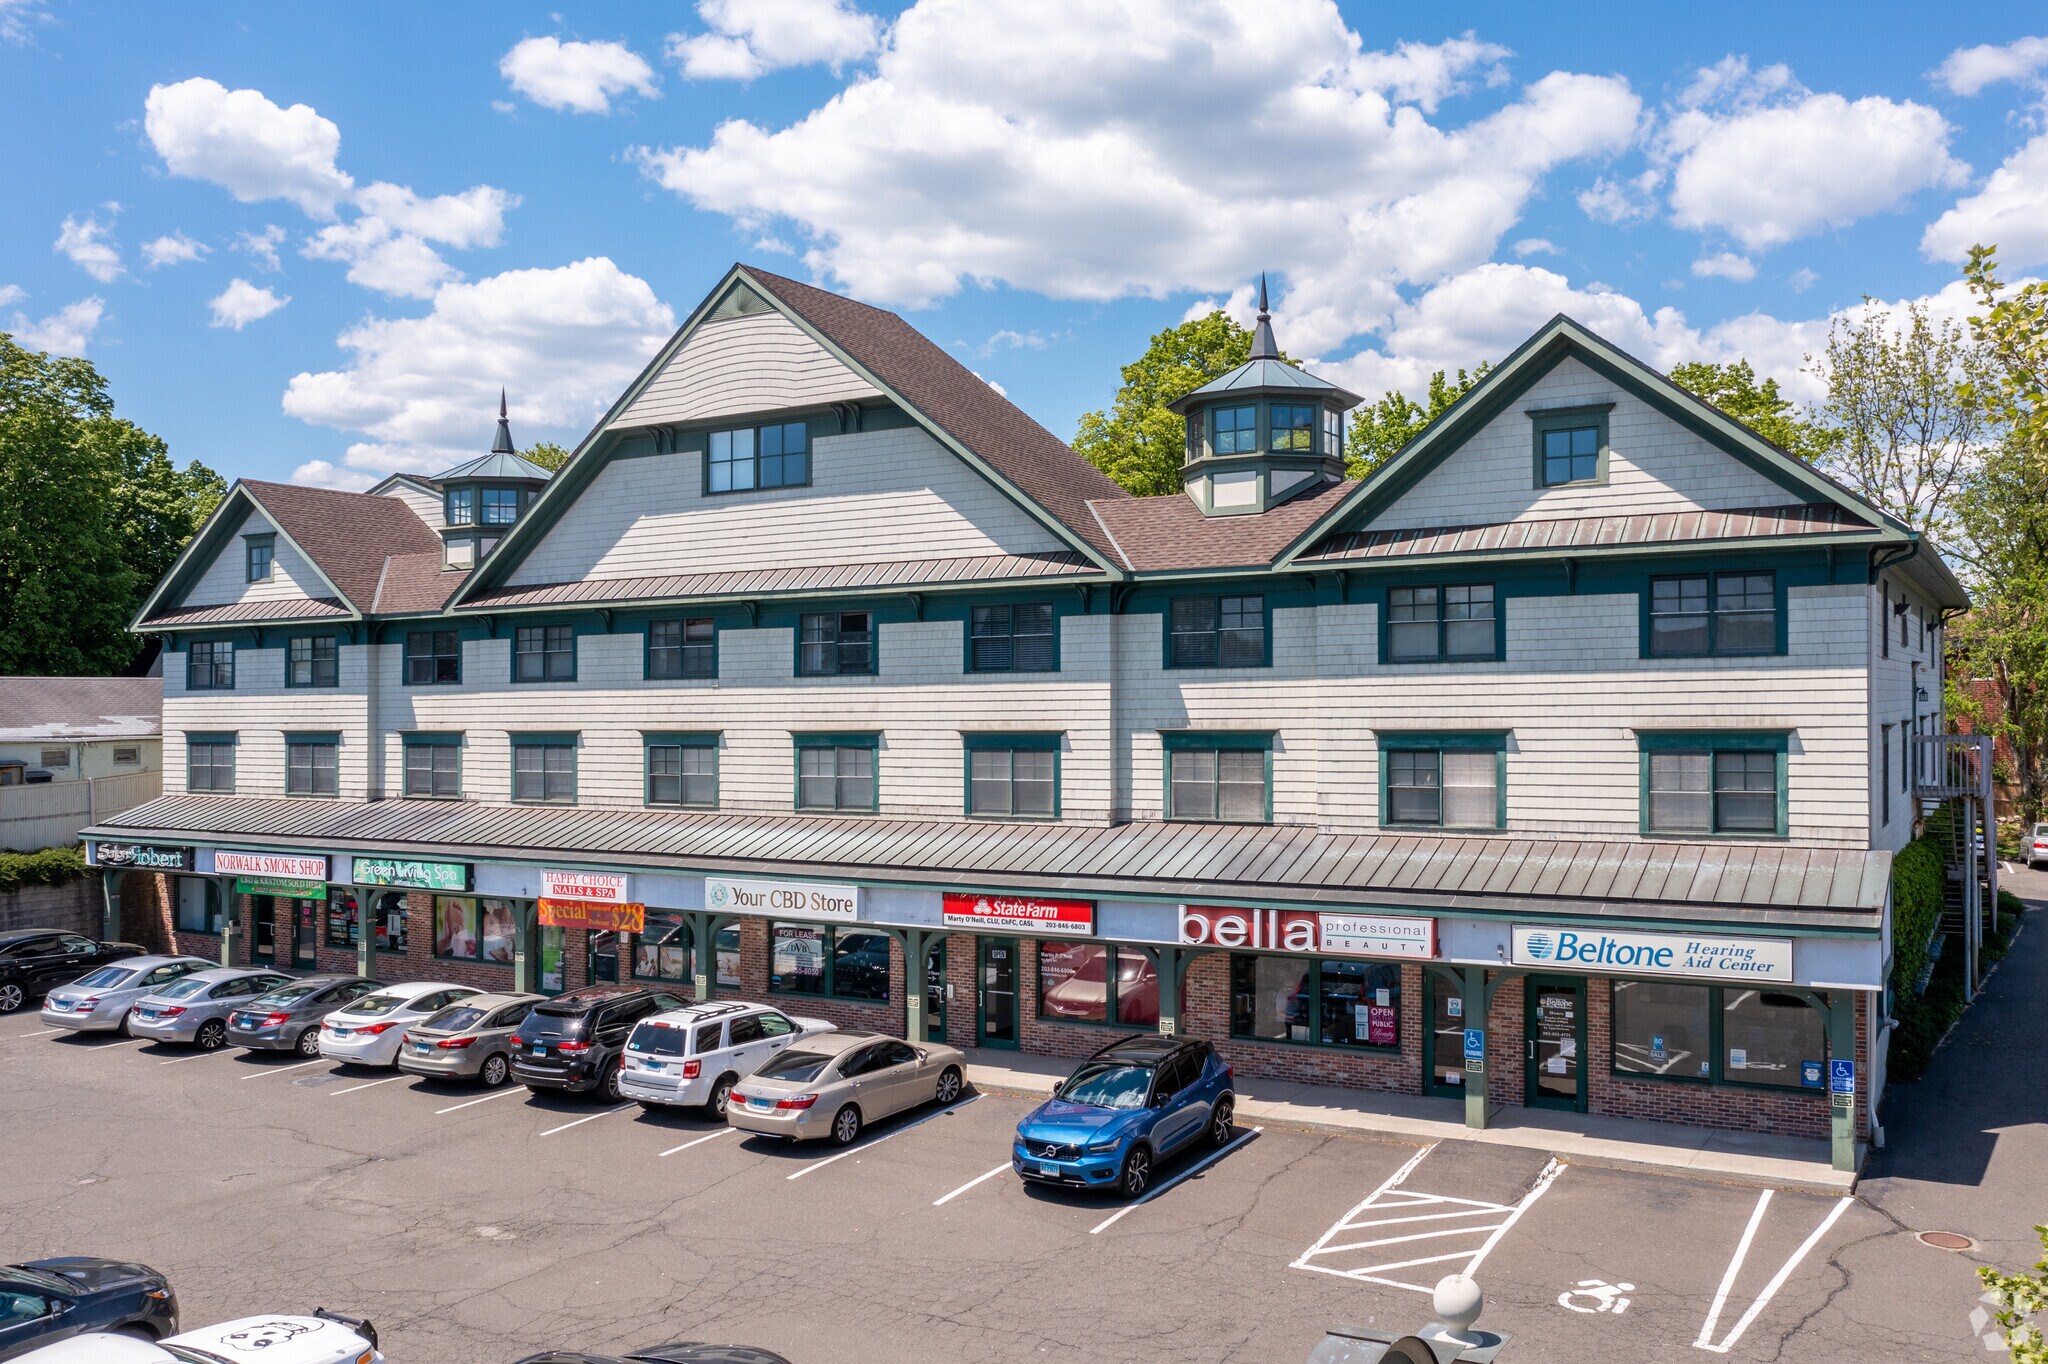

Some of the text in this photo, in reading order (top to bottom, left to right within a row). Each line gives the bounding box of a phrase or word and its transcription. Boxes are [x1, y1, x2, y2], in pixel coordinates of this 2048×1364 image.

[128, 846, 182, 867] Robert
[217, 855, 324, 876] NORWALK SMOKE SHOP
[360, 861, 457, 884] Green Living Spa
[240, 875, 254, 884] CBD
[260, 877, 287, 887] KRATOM
[288, 879, 305, 888] SOLD
[306, 881, 323, 889] HERE
[546, 872, 623, 888] HAPPY CHOICE
[554, 885, 614, 898] NAILS & SPA
[732, 886, 853, 913] Your CBD Store
[540, 898, 588, 924] Special
[587, 903, 612, 912] Manicure
[588, 918, 610, 927] Pedicure
[612, 902, 644, 931] $28
[947, 915, 965, 924] Marty
[966, 916, 986, 925] O'Neill,
[986, 918, 1001, 926] CLU,
[1045, 921, 1086, 931] 203-846-6803
[779, 929, 817, 940] FOR LEASE
[1178, 904, 1319, 952] bella
[1325, 921, 1427, 937] professional
[790, 942, 808, 954] DVB
[1326, 939, 1427, 952] BEAUTY
[1554, 932, 1757, 969] Beltone Hearing
[1682, 956, 1775, 973] Aid Center
[1370, 1007, 1394, 1017] OPEN
[1371, 1020, 1394, 1028] PUBLIC
[1465, 1049, 1482, 1057] PARKING
